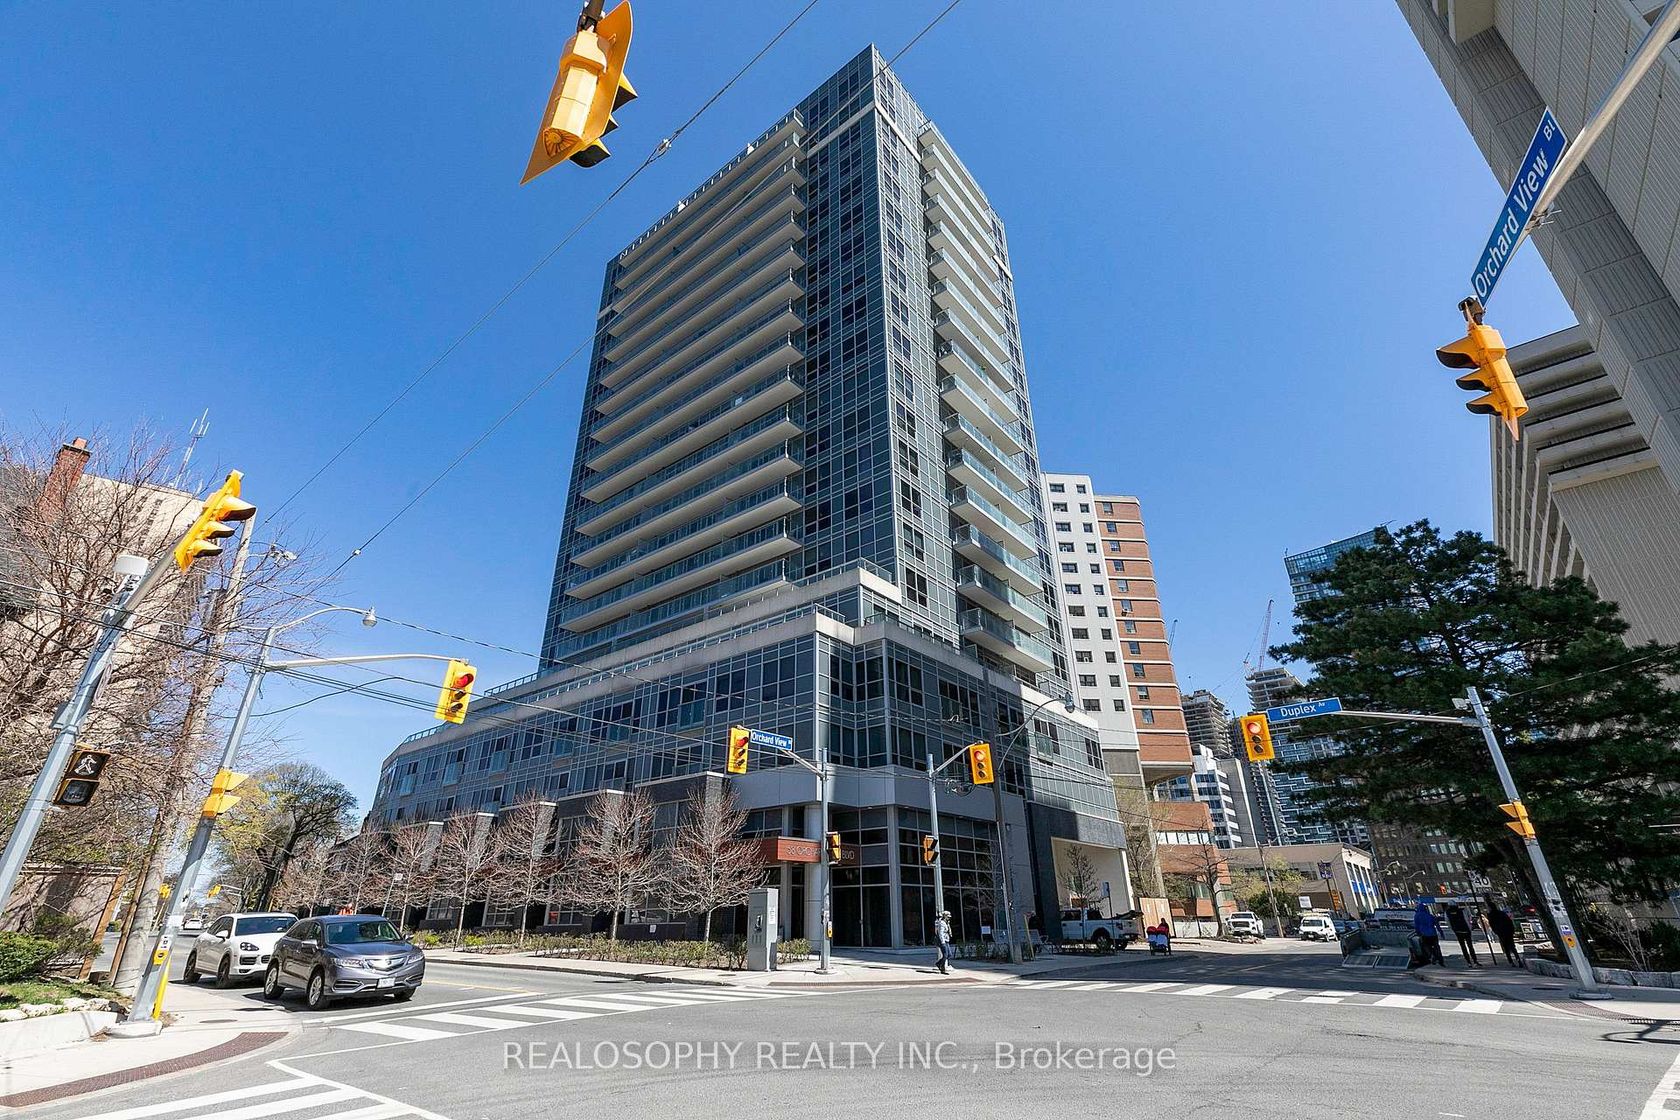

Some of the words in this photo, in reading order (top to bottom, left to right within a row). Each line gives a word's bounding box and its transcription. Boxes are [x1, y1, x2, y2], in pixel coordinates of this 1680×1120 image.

[1474, 207, 1520, 299] Orchard
[1513, 147, 1549, 212] View
[1543, 119, 1556, 142] Bl
[1280, 704, 1317, 717] Duplex
[752, 731, 774, 745] Orchard
[774, 736, 787, 747] View
[1474, 876, 1489, 886] 40
